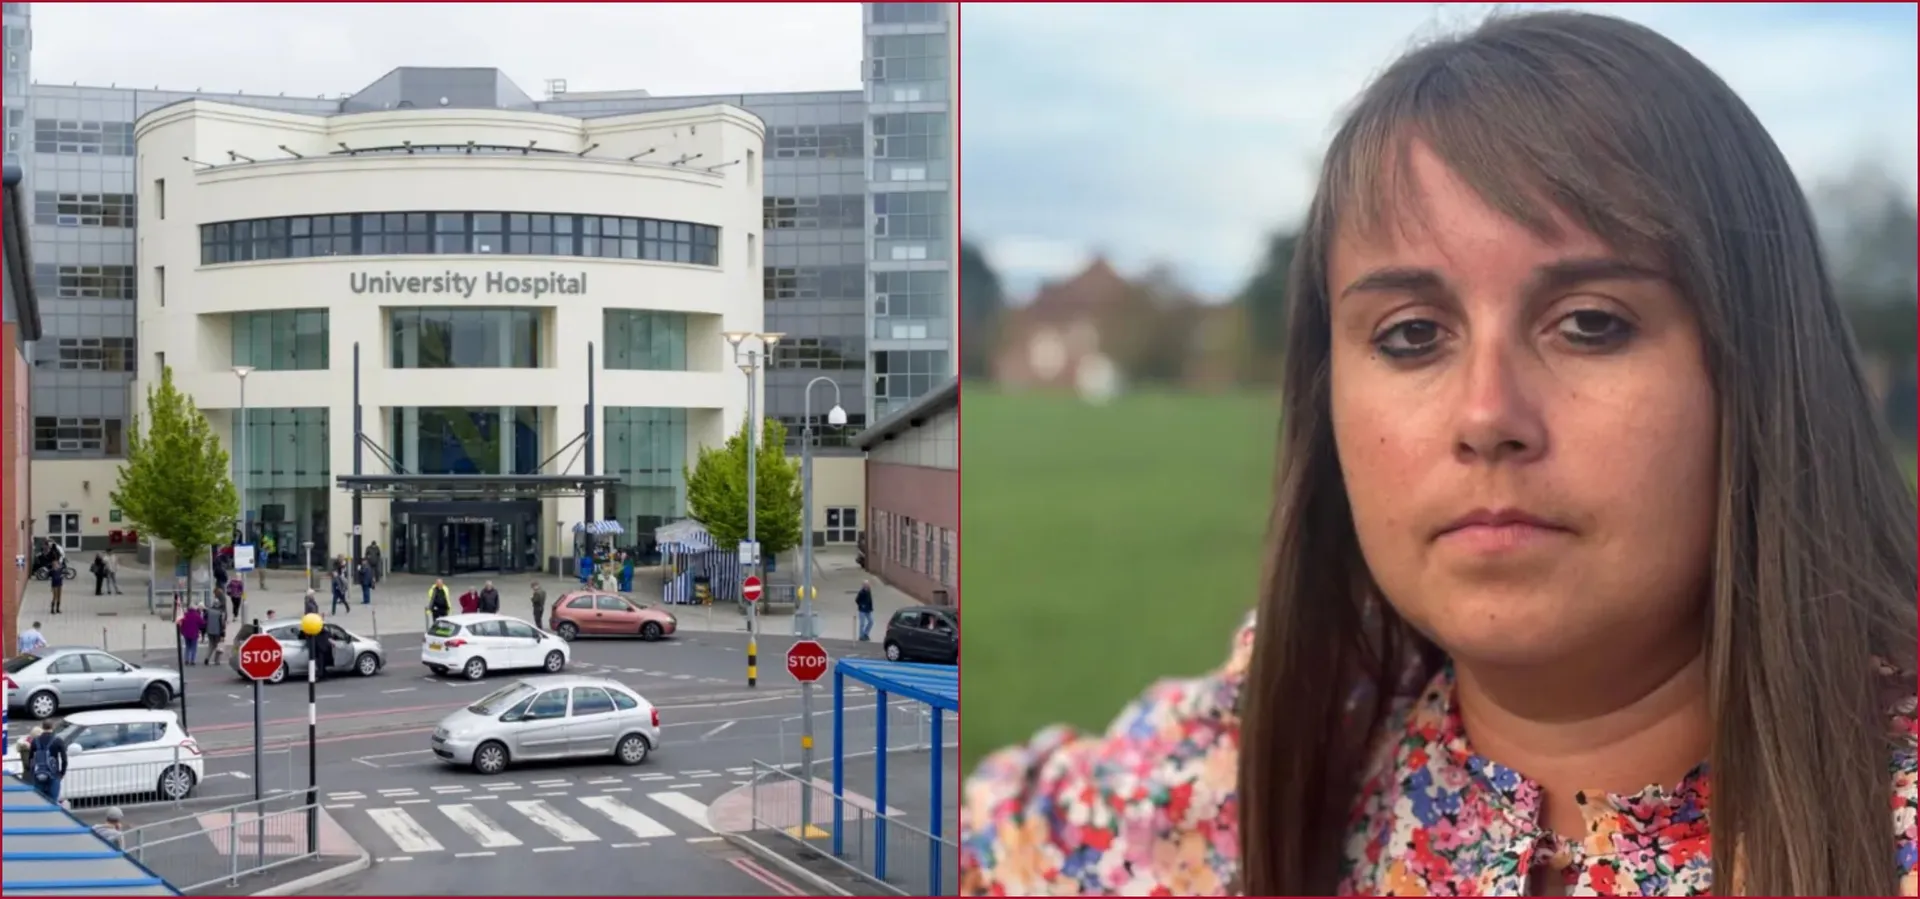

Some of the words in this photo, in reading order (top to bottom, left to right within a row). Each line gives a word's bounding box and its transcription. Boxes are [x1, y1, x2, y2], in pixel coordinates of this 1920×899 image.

[350, 270, 477, 298] University
[486, 271, 587, 299] Hospital
[243, 650, 281, 664] STOP
[789, 655, 826, 667] STOP
